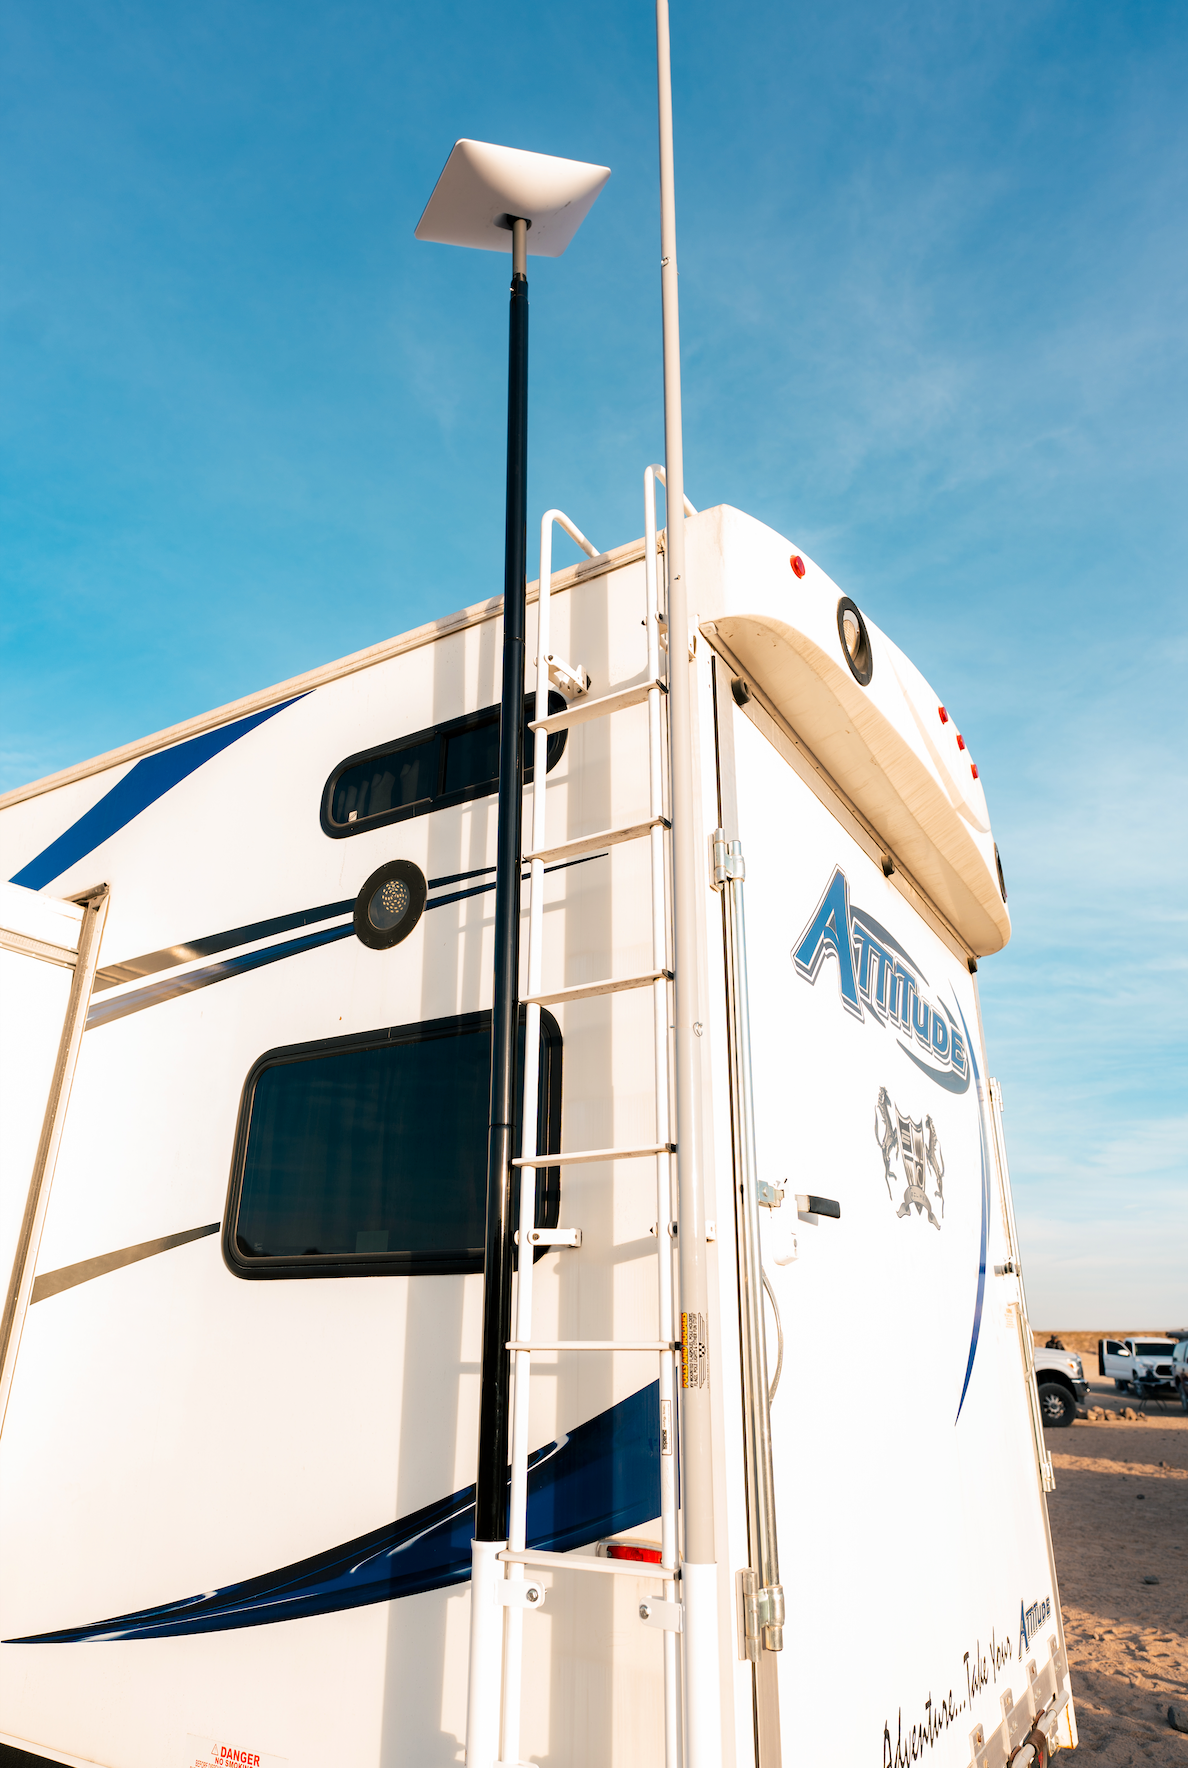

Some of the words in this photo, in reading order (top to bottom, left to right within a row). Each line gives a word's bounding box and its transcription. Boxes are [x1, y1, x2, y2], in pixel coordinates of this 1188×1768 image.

[791, 864, 967, 1081] ATTITUDE
[681, 1347, 689, 1364] AND
[963, 1638, 989, 1711] Take
[989, 1626, 1012, 1684] Your
[215, 1757, 224, 1766] NO
[220, 1746, 260, 1768] DANGER
